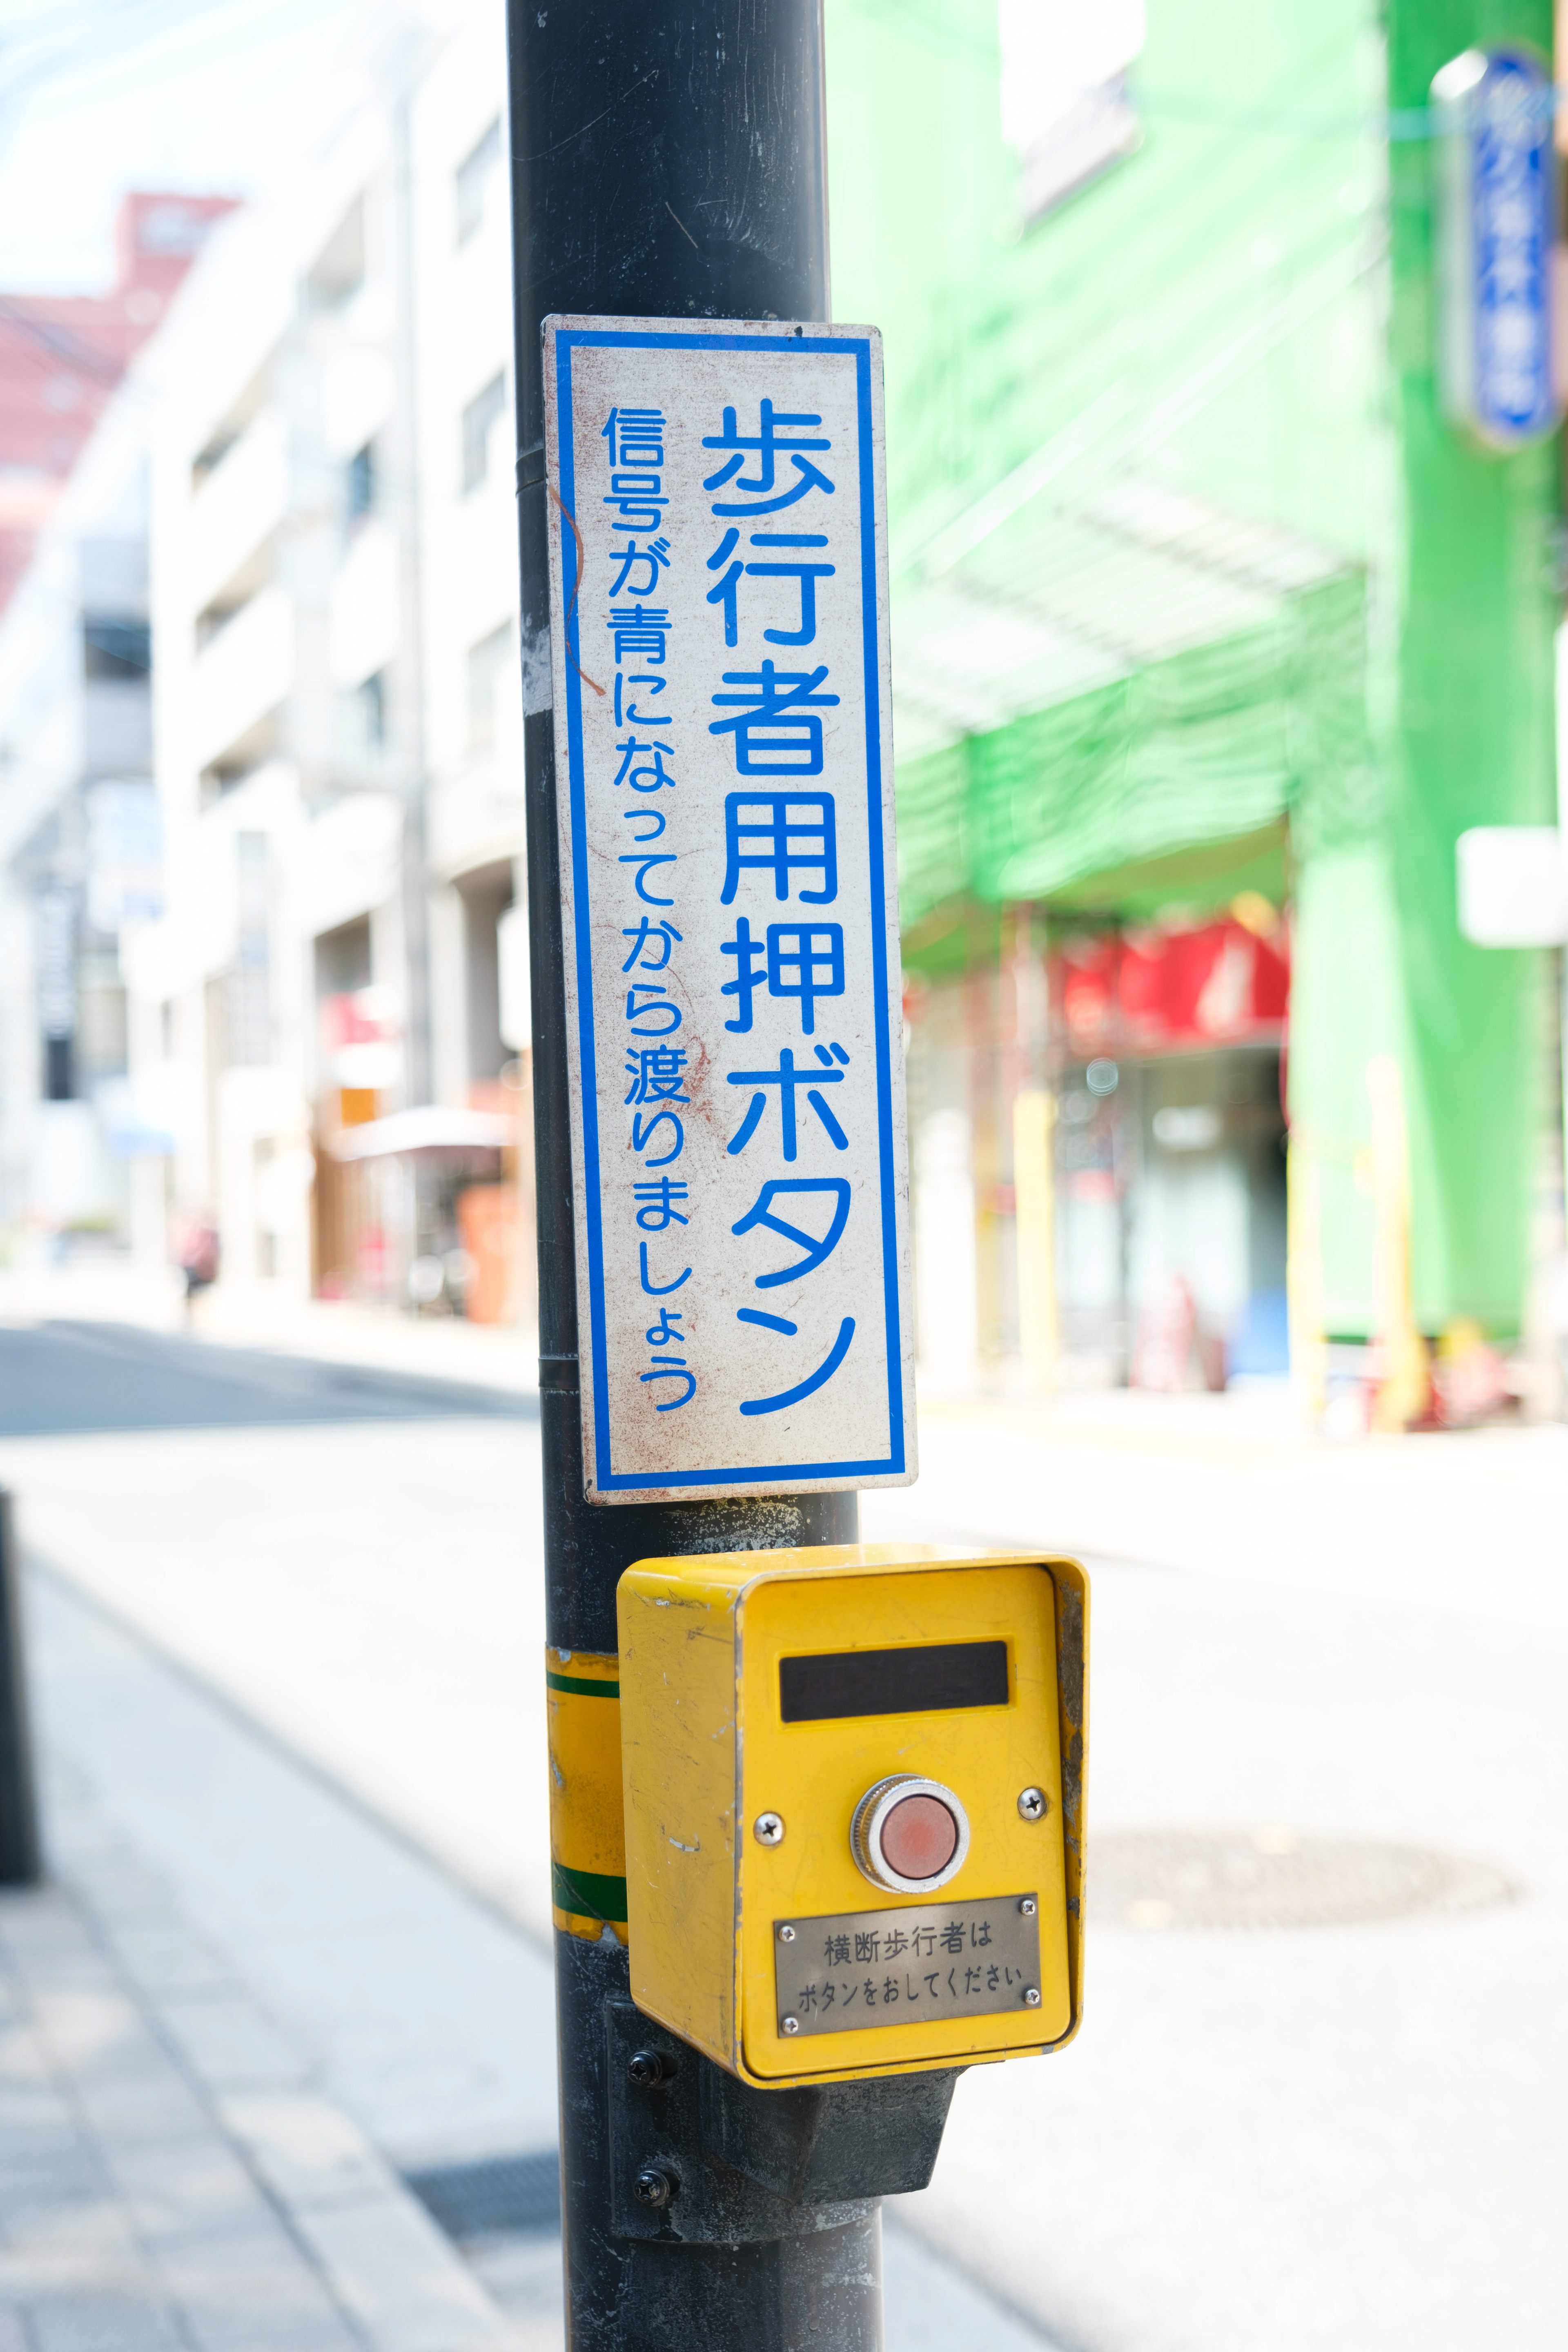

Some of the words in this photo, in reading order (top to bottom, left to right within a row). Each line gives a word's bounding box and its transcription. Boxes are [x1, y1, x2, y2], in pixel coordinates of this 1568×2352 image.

[601, 407, 697, 1412] 信号が青になってから渡りましょう
[702, 398, 856, 1416] 歩行者用押ボタン
[798, 1965, 1022, 2013] ボタンをおしてください
[824, 1922, 992, 1967] 横断歩行者は
